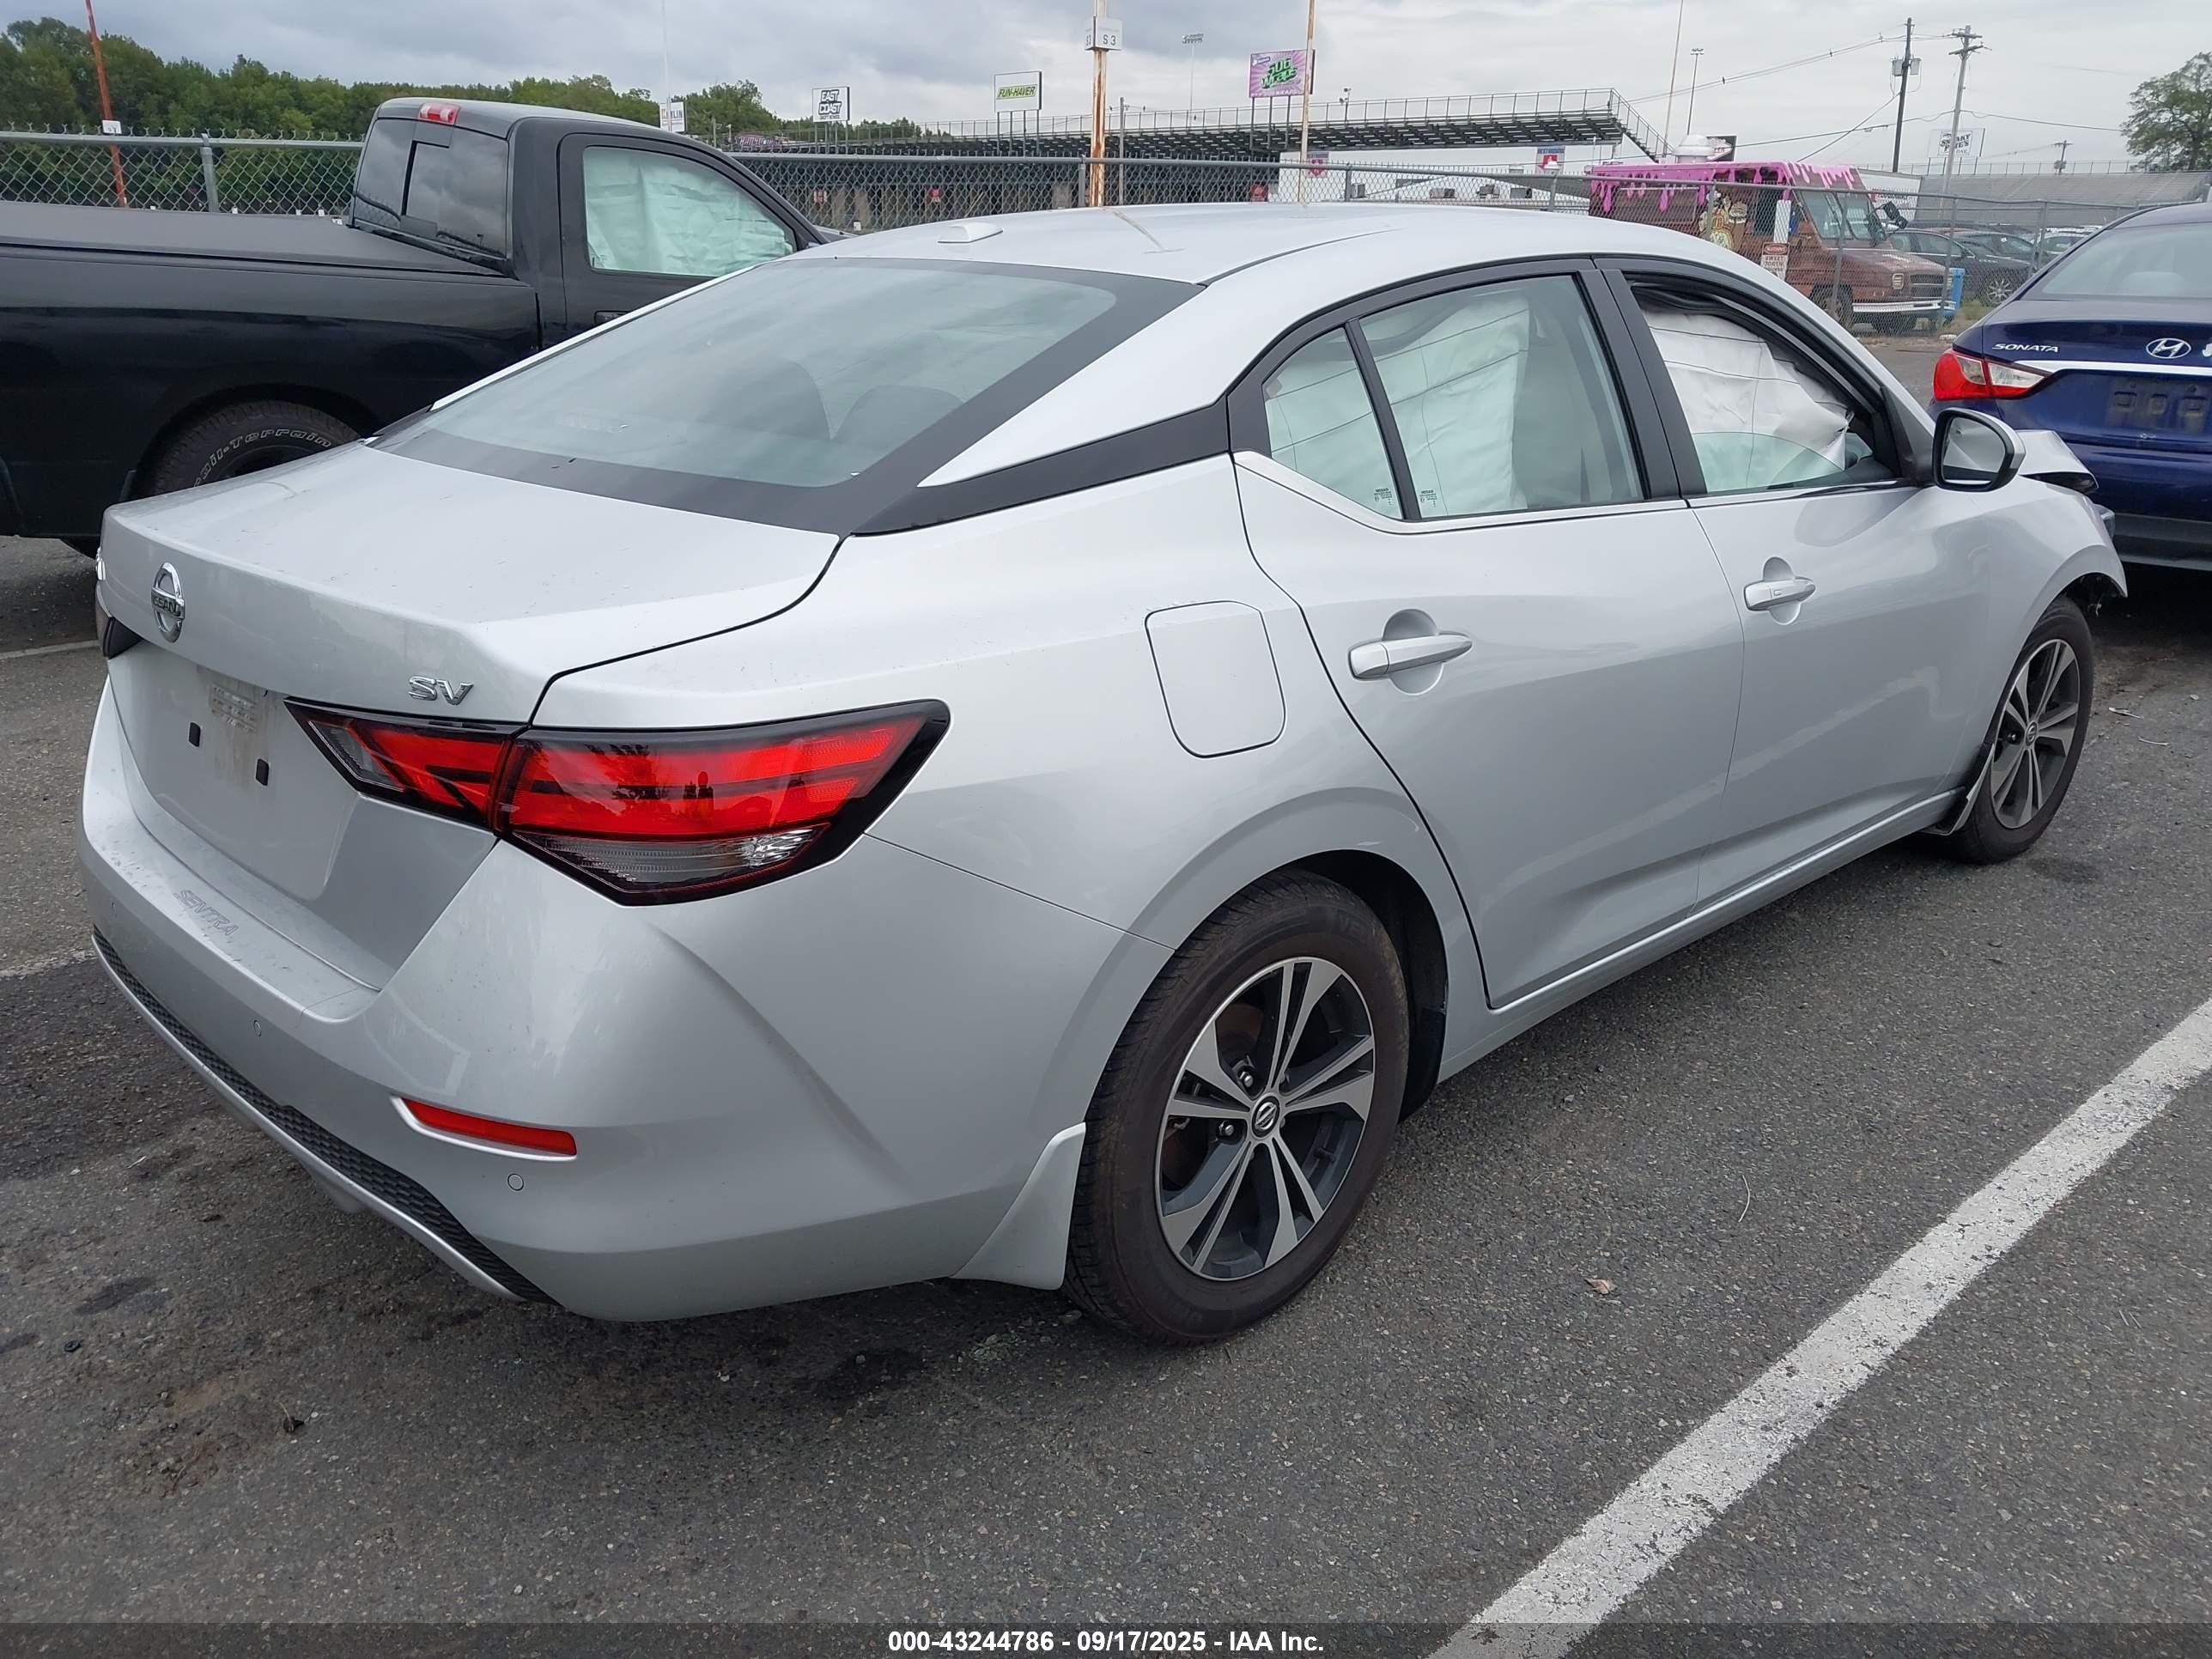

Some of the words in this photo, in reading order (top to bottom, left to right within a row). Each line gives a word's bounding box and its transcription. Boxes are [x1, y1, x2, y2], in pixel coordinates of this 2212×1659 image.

[820, 88, 841, 103] EAST
[997, 86, 1036, 98] FUN-HAVER
[817, 100, 842, 115] COAST
[1939, 132, 1972, 148] SNAKY
[1991, 343, 2059, 354] SONATA
[407, 675, 475, 706] SV
[173, 889, 239, 936] SENTRA
